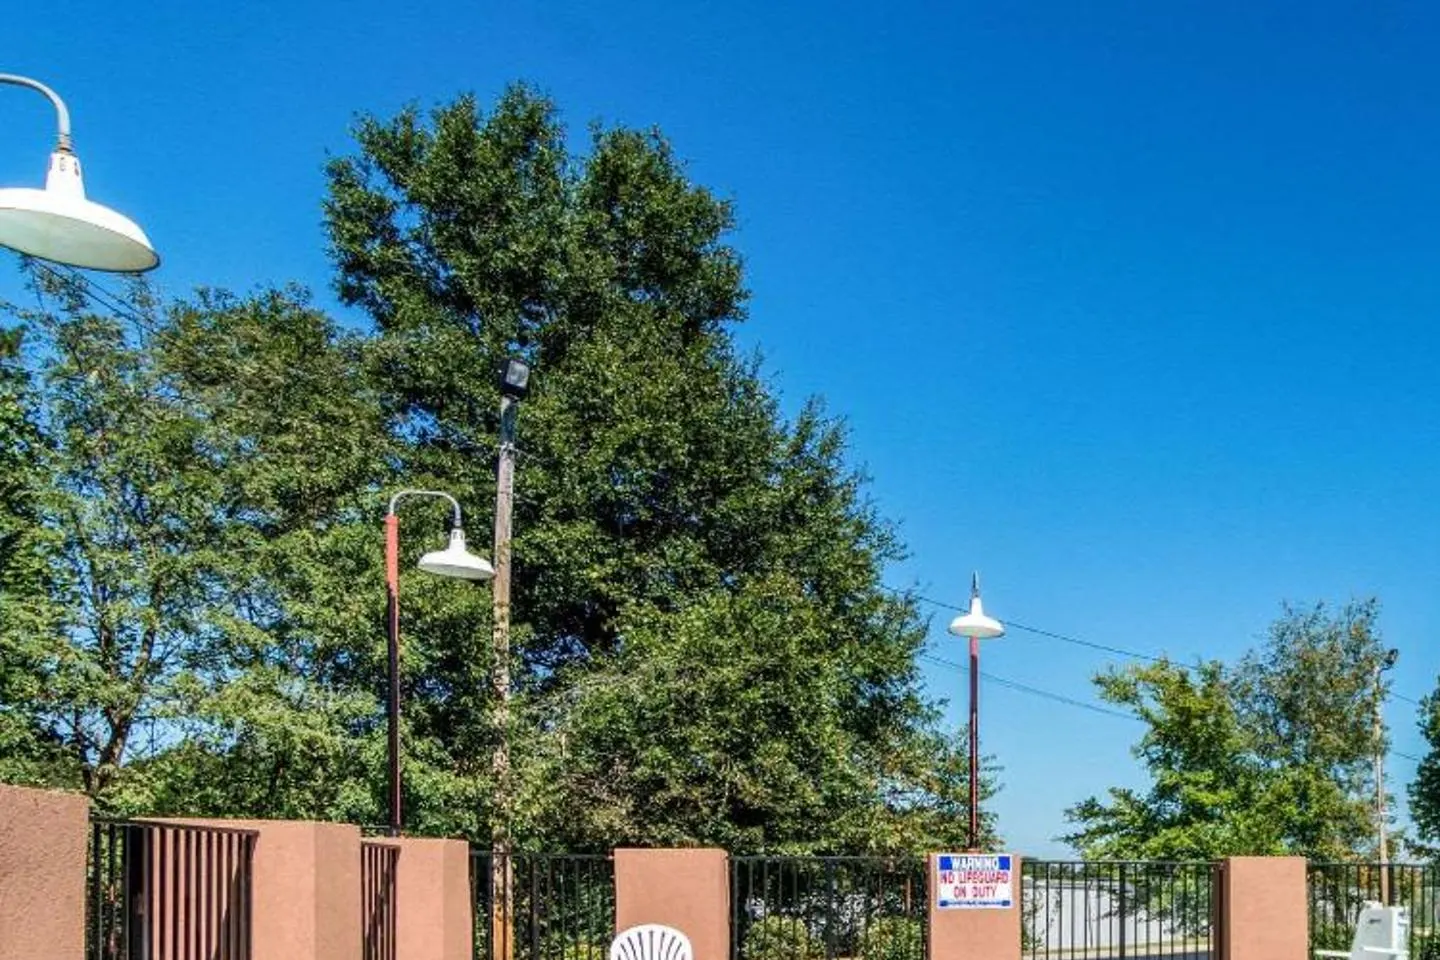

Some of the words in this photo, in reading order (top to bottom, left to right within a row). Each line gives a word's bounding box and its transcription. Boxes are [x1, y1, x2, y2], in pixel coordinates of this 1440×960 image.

[952, 856, 998, 870] WARNING
[940, 871, 955, 884] NO
[959, 870, 1009, 884] LIFEGUARD
[954, 886, 966, 898] ON
[971, 886, 997, 898] DUTY
